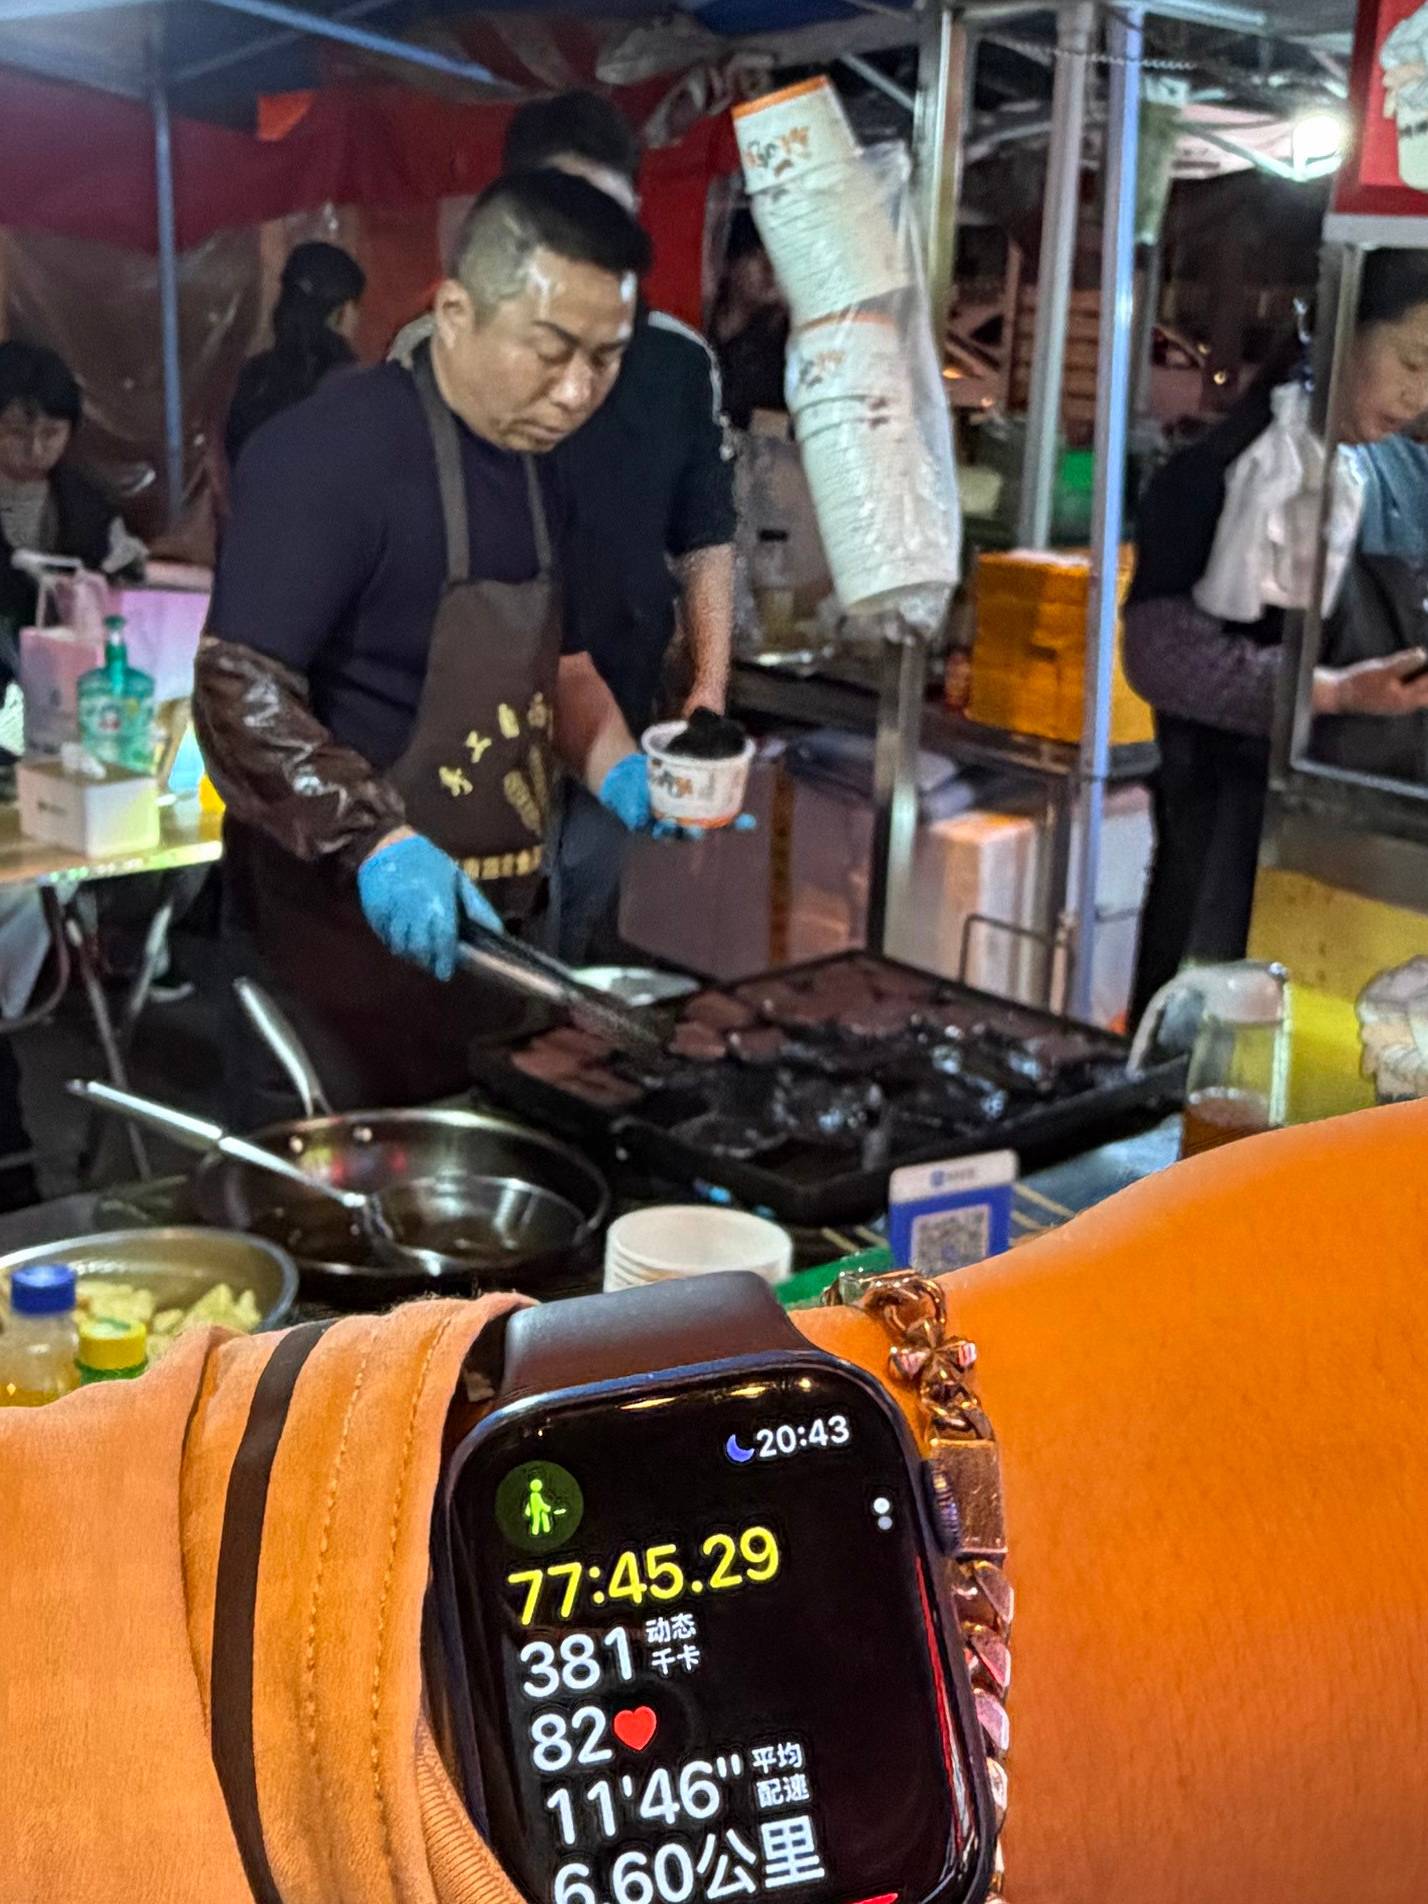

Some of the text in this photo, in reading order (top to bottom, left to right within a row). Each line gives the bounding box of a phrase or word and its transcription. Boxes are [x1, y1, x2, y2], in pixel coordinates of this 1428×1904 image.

[756, 1415, 851, 1460] 20:43
[507, 1526, 780, 1626] 77:45.29
[645, 1613, 698, 1644] 动态
[520, 1628, 634, 1698] 381
[650, 1645, 700, 1676] 千卡
[529, 1706, 612, 1772] 82
[752, 1741, 804, 1771] 平均
[755, 1773, 810, 1806] 配速
